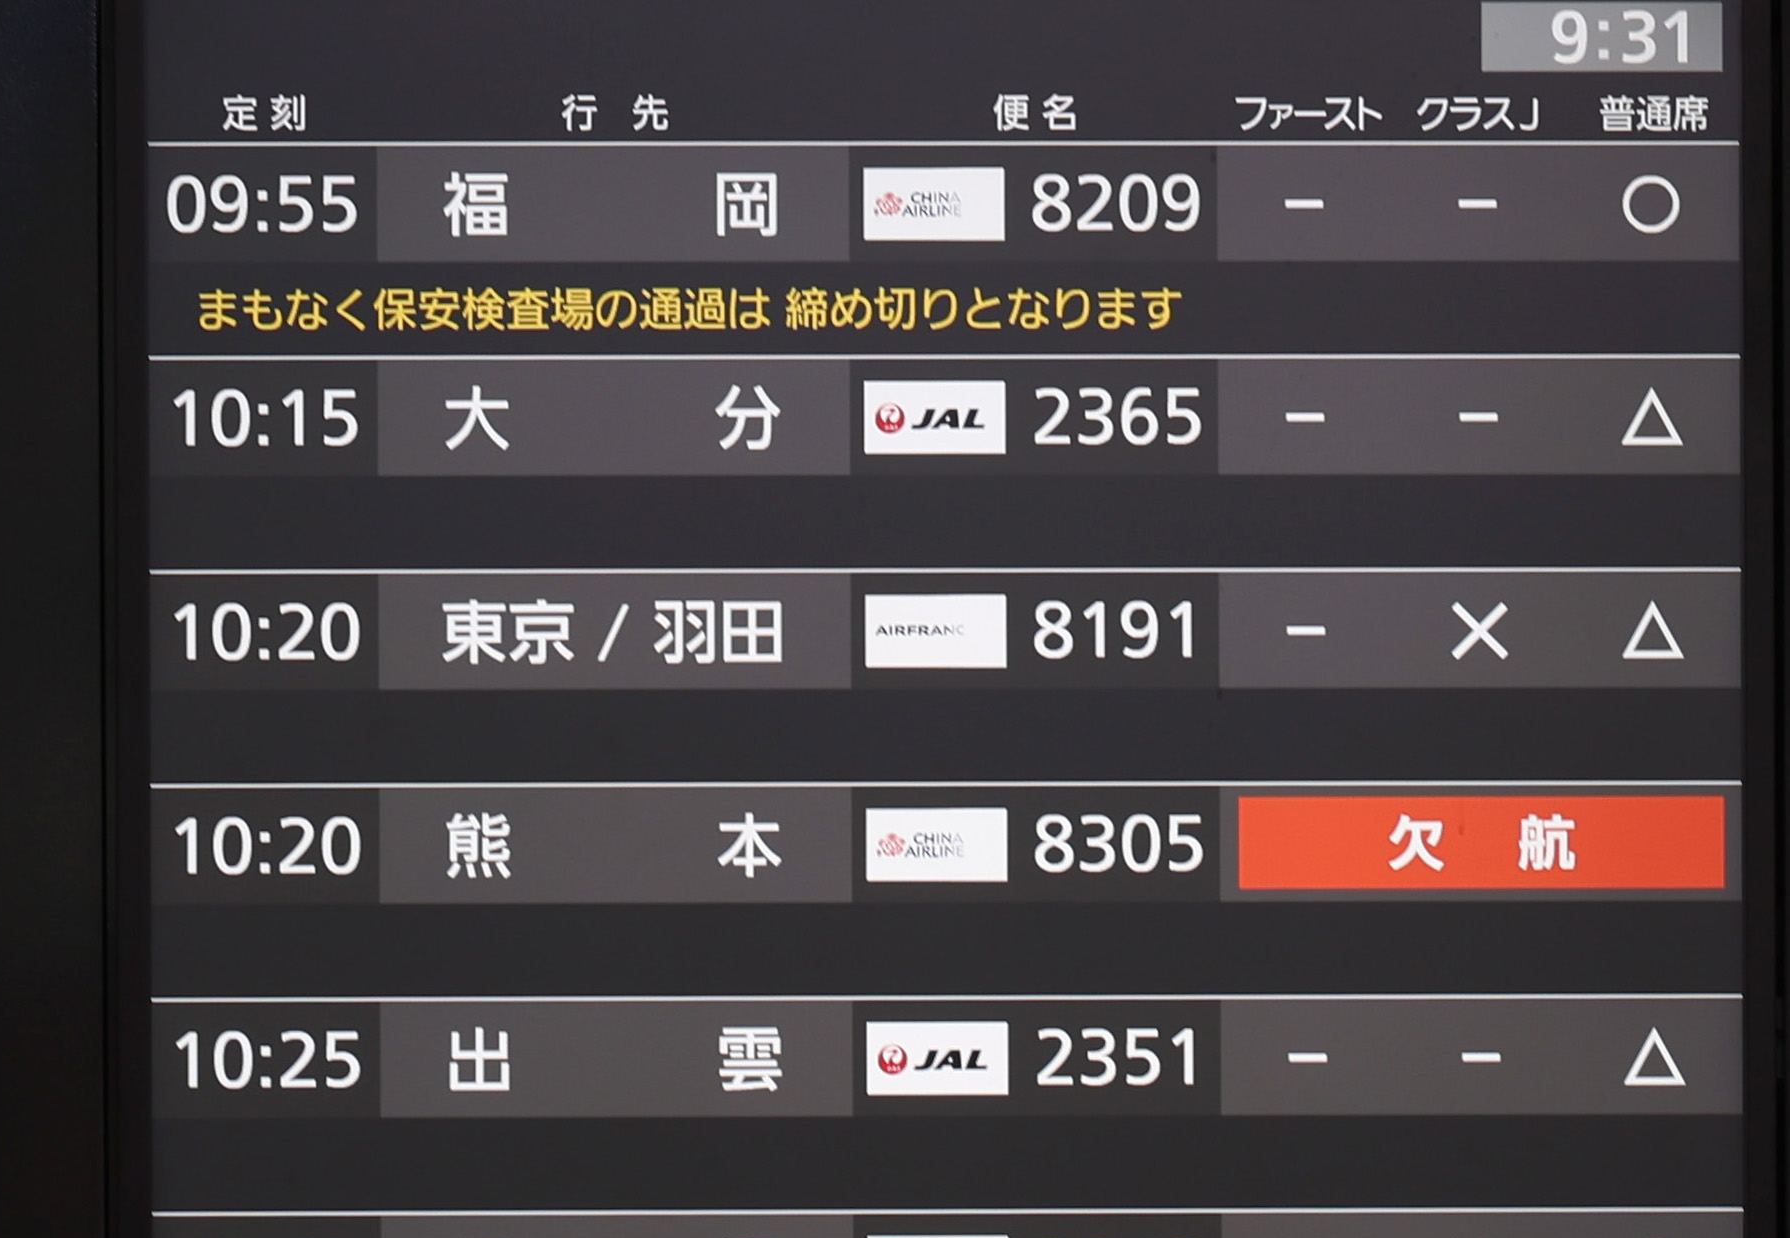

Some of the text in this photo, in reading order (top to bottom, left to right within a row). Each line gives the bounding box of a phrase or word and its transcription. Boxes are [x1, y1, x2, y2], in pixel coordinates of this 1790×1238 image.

[1552, 10, 1688, 64] 9:31
[222, 94, 306, 131] 定刻
[993, 93, 1076, 132] 便名
[1235, 96, 1383, 131] ファースト
[1416, 96, 1539, 132] クラスJ
[1599, 94, 1709, 132] 普通席
[167, 174, 358, 234] 09:55
[909, 190, 962, 205] CHINA
[1031, 173, 1200, 232] 8209
[785, 286, 1183, 331] 締め切りとなります
[173, 388, 358, 447] 10:15
[911, 408, 985, 430] JAL
[1034, 386, 1202, 446] 2365
[174, 602, 360, 661] 10:20
[1033, 600, 1193, 659] 8191
[175, 816, 361, 875] 10:20
[912, 831, 964, 845] CHINA
[1034, 813, 1204, 873] 8305
[175, 1030, 361, 1089] 10:25
[914, 1049, 987, 1071] JAL
[1036, 1027, 1194, 1086] 2351
